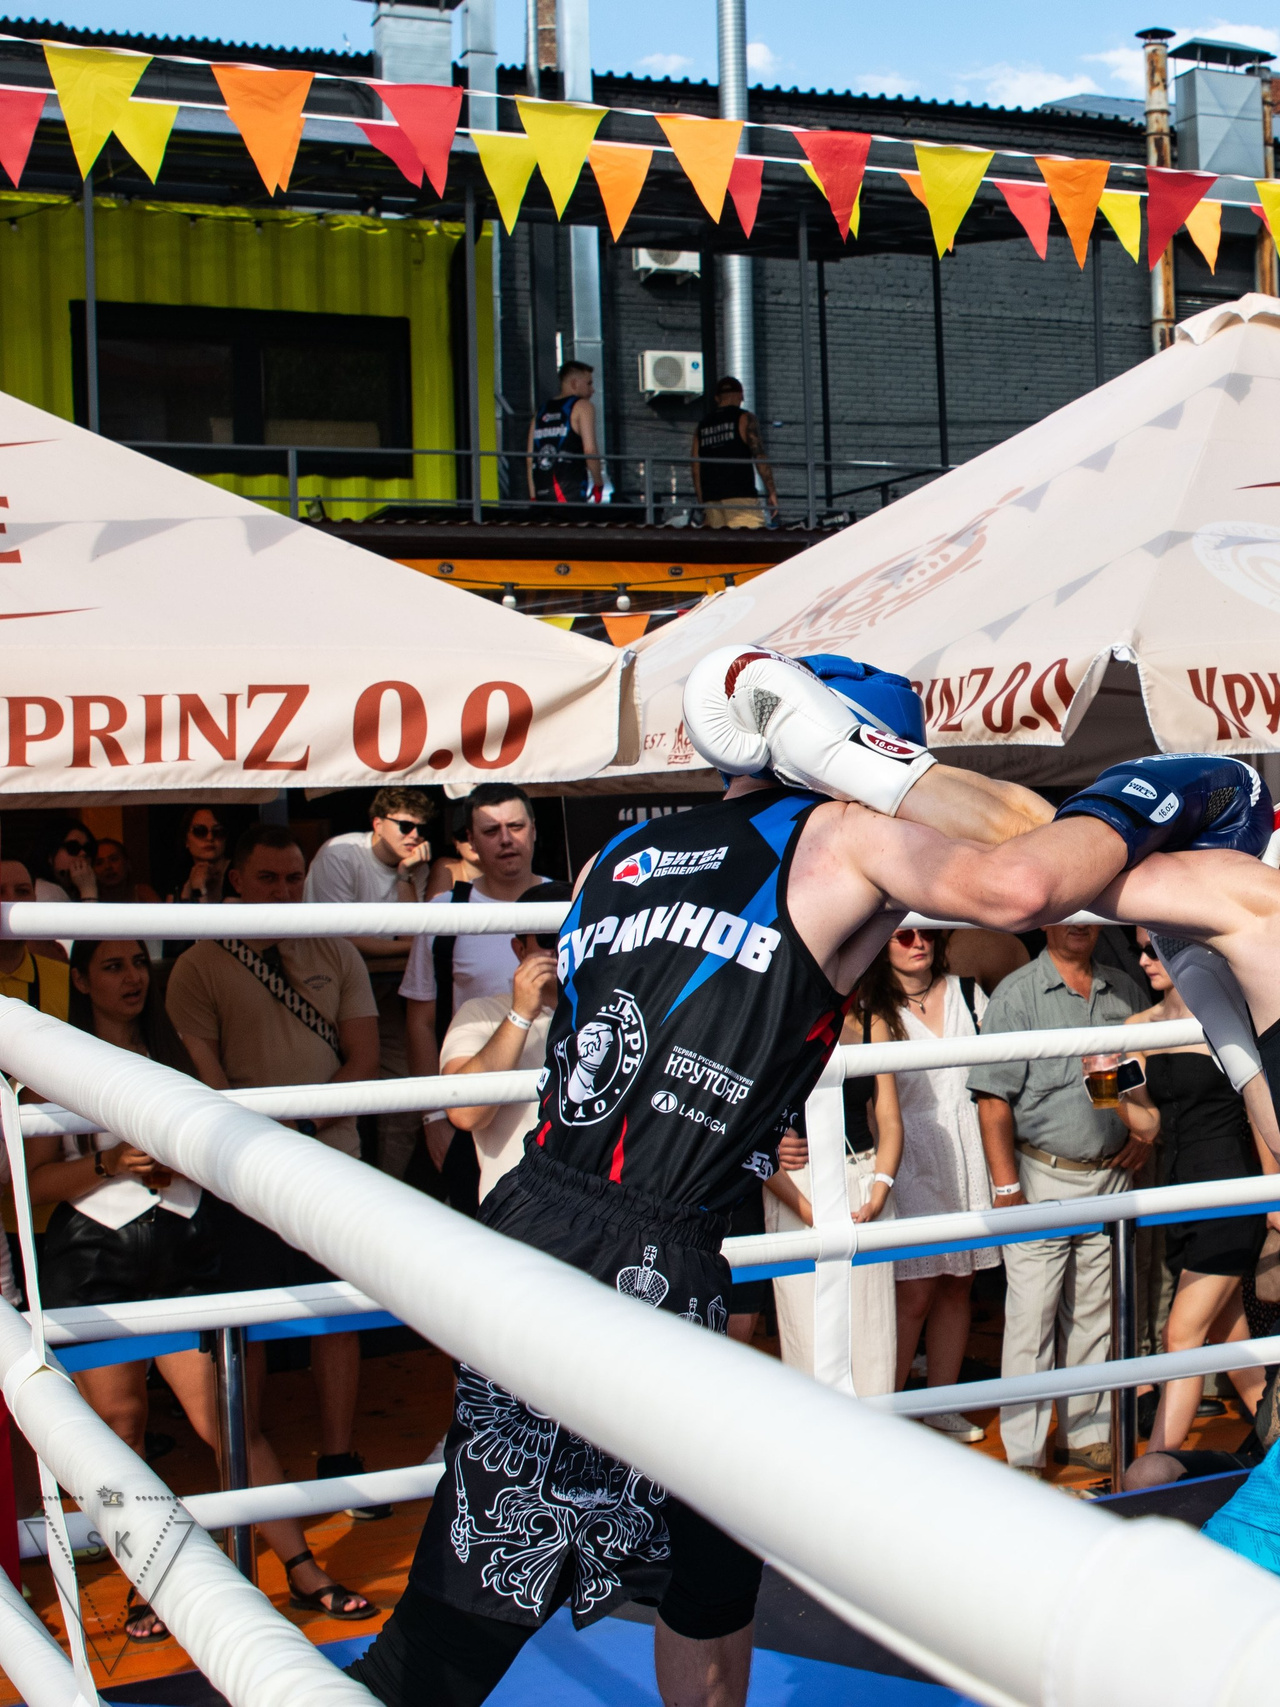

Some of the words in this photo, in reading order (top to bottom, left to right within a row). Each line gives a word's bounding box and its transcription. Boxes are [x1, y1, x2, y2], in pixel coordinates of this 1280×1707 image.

[352, 680, 534, 773] 0.0
[643, 732, 667, 751] EST.
[658, 845, 729, 868] БИТВА
[556, 901, 782, 985] БУРМИНОВ
[678, 1103, 728, 1136] LADOGA
